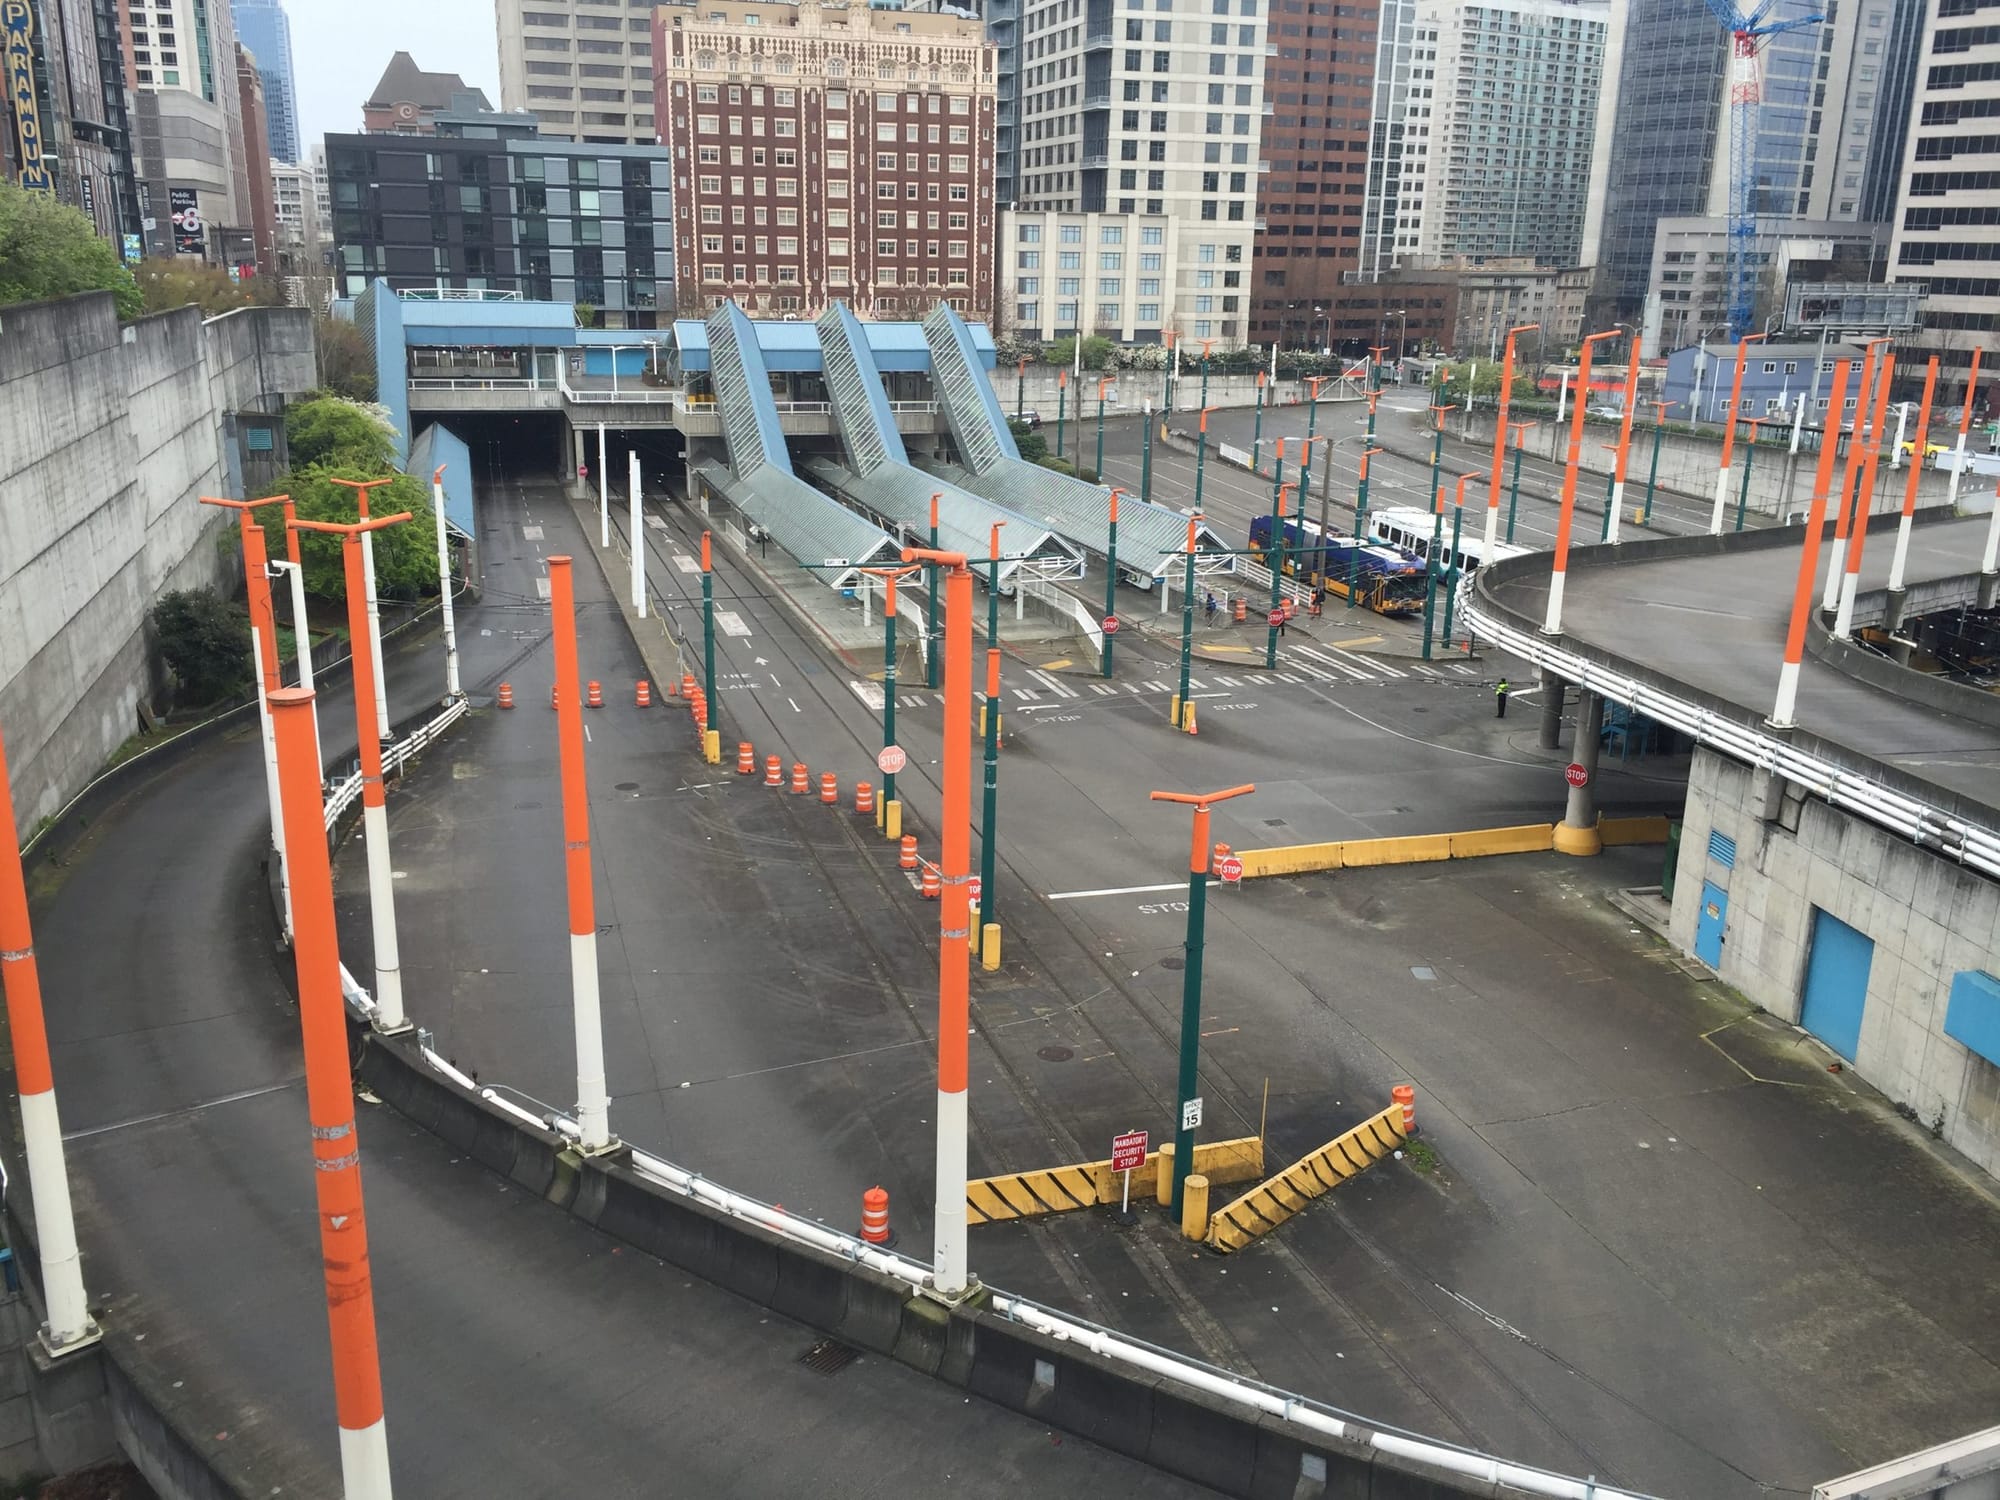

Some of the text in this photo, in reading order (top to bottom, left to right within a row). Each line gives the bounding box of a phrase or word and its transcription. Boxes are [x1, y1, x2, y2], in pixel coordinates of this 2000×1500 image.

[6, 4, 43, 185] PARAMOUN
[880, 753, 904, 767] STOP
[1567, 769, 1586, 781] STOP
[1222, 865, 1241, 874] STOP
[1138, 902, 1189, 914] STO
[1186, 1113, 1198, 1126] 15
[1115, 1136, 1146, 1147] MANDATORY
[1114, 1146, 1145, 1158] SECURITY
[1120, 1157, 1138, 1167] STOP
